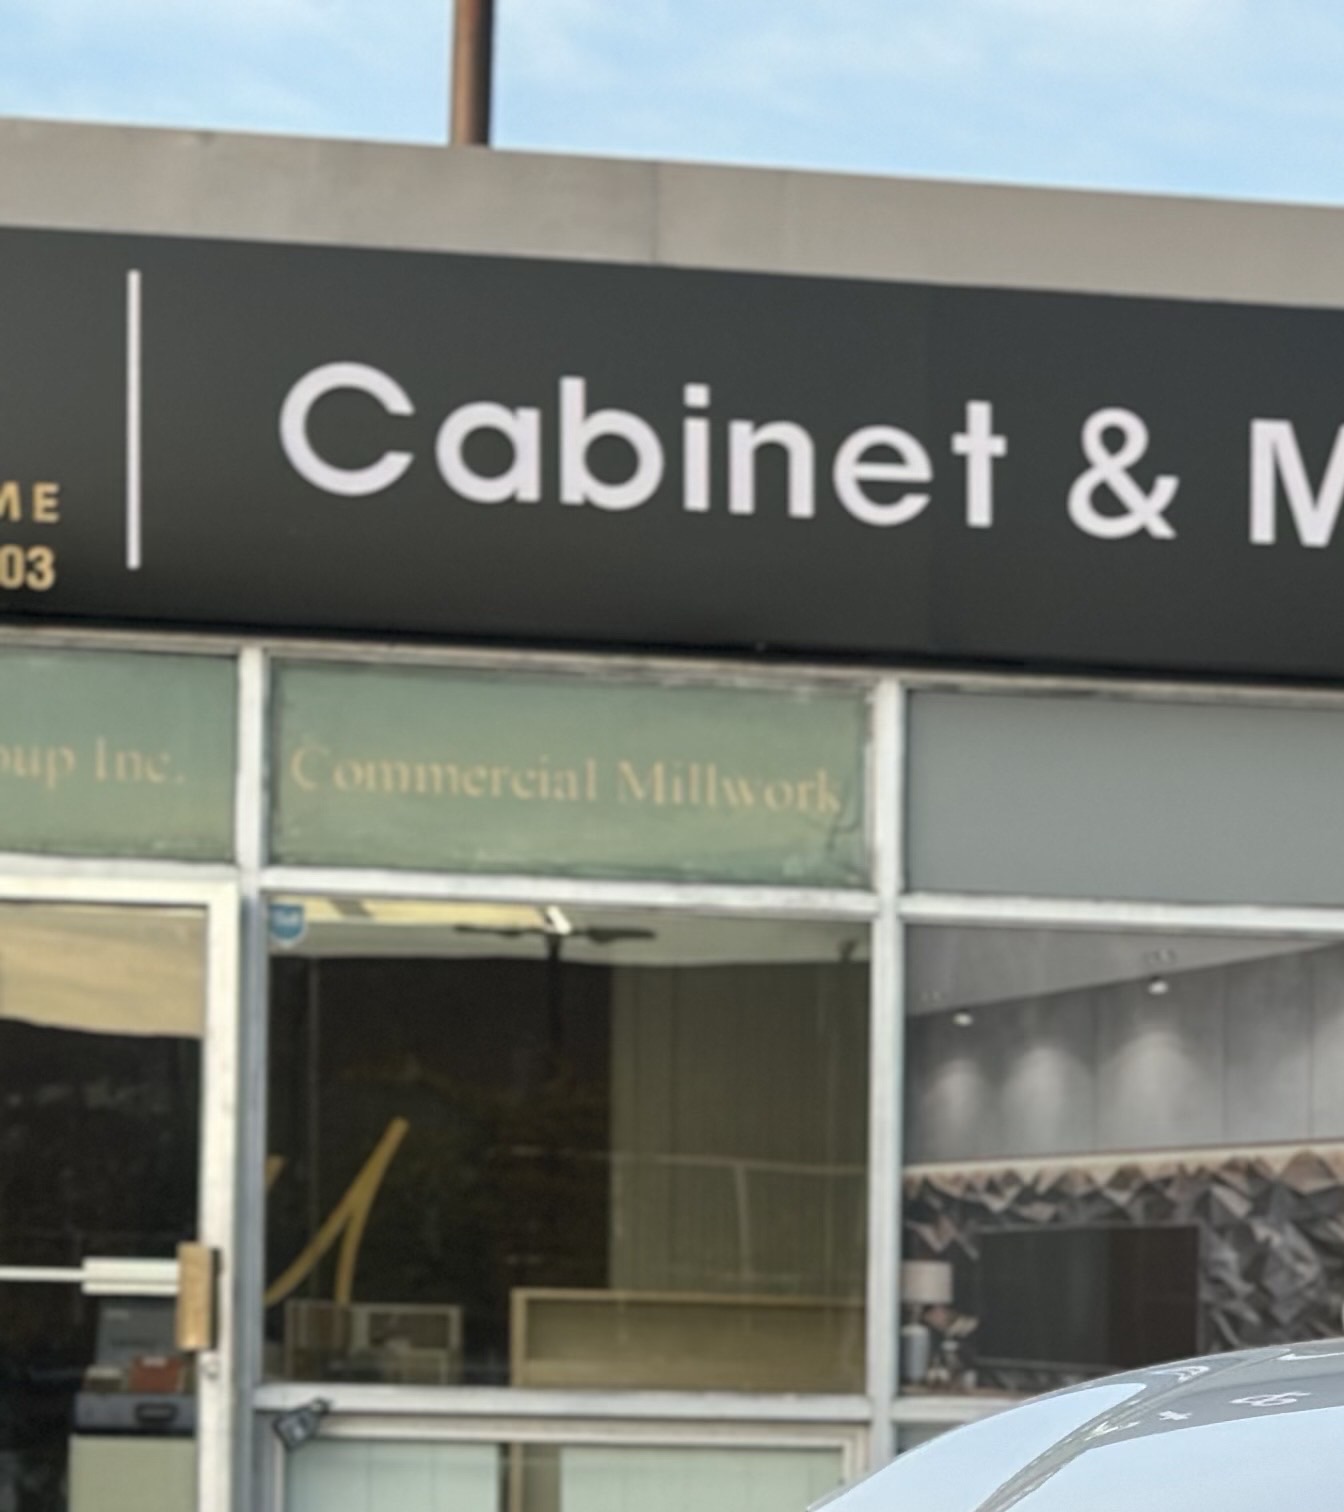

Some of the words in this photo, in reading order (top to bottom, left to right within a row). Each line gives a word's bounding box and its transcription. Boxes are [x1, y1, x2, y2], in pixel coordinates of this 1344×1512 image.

[279, 360, 1007, 529] Cabinet
[1067, 407, 1180, 540] &
[290, 743, 597, 804] Commercial
[616, 758, 842, 814] Millwork
